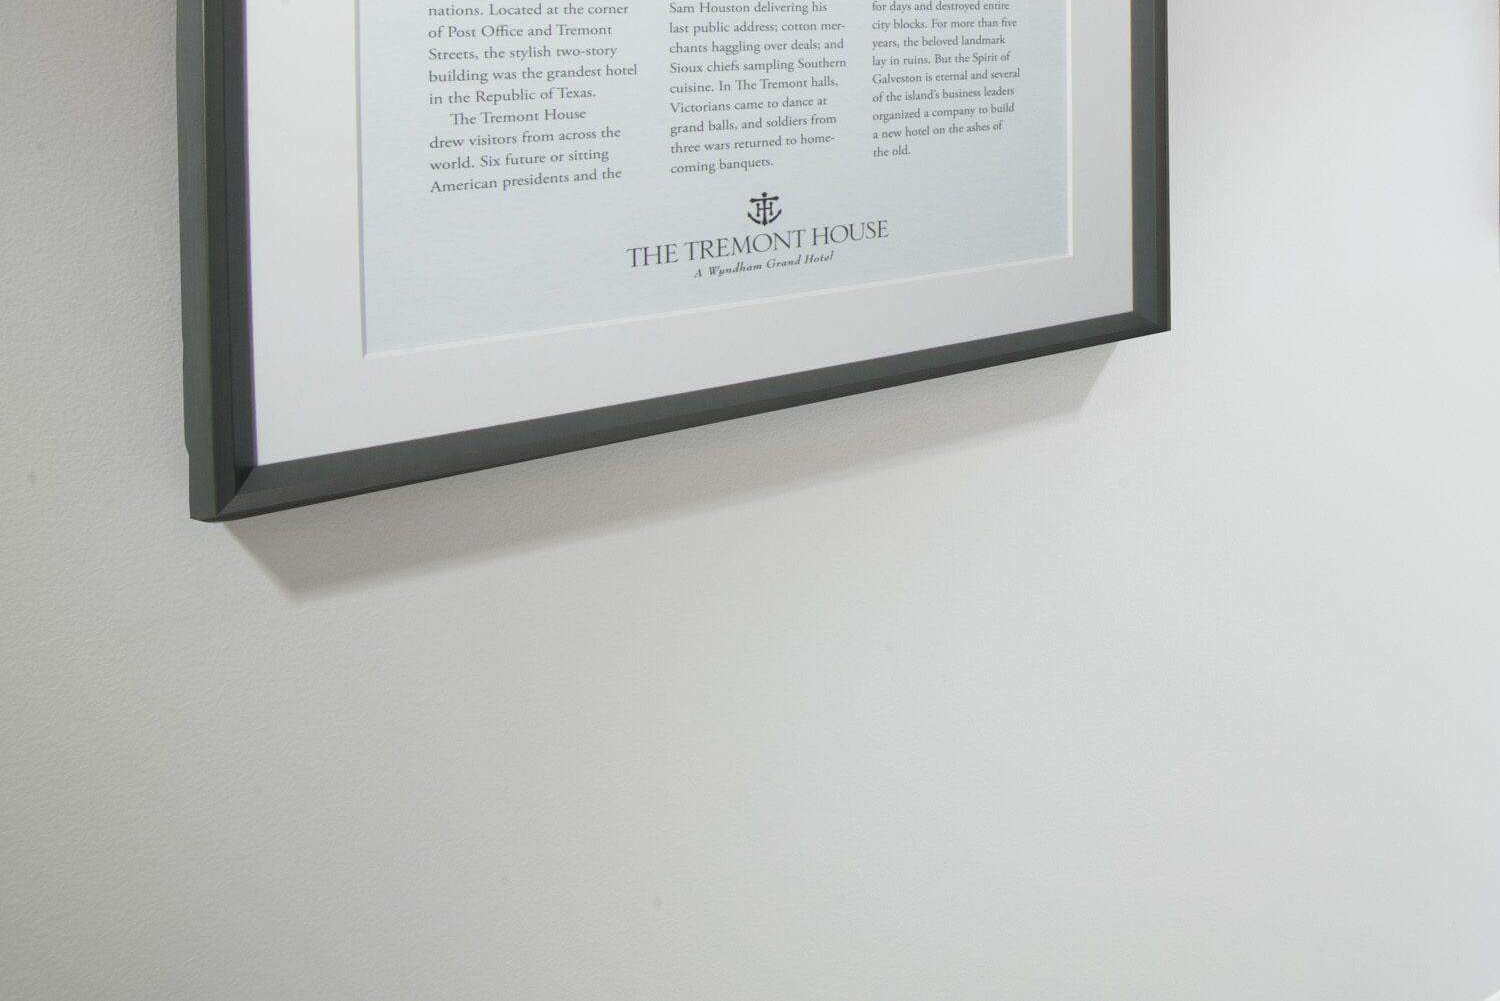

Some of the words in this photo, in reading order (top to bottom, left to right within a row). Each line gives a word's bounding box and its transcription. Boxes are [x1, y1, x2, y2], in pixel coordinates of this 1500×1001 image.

[429, 5, 484, 16] nations.
[489, 3, 542, 16] Located
[546, 7, 559, 15] at
[563, 2, 584, 15] the
[587, 6, 629, 15] corner
[669, 2, 695, 14] Sam
[699, 1, 751, 14] Houston
[753, 1, 809, 16] delivering
[811, 1, 828, 12] his
[626, 244, 680, 268] THE
[683, 229, 806, 262] TREMONT
[812, 219, 890, 246] HOUSE
[693, 268, 703, 278] A
[708, 261, 763, 277] Wyndham
[766, 255, 801, 270] Grand
[805, 251, 834, 265] Hotel
